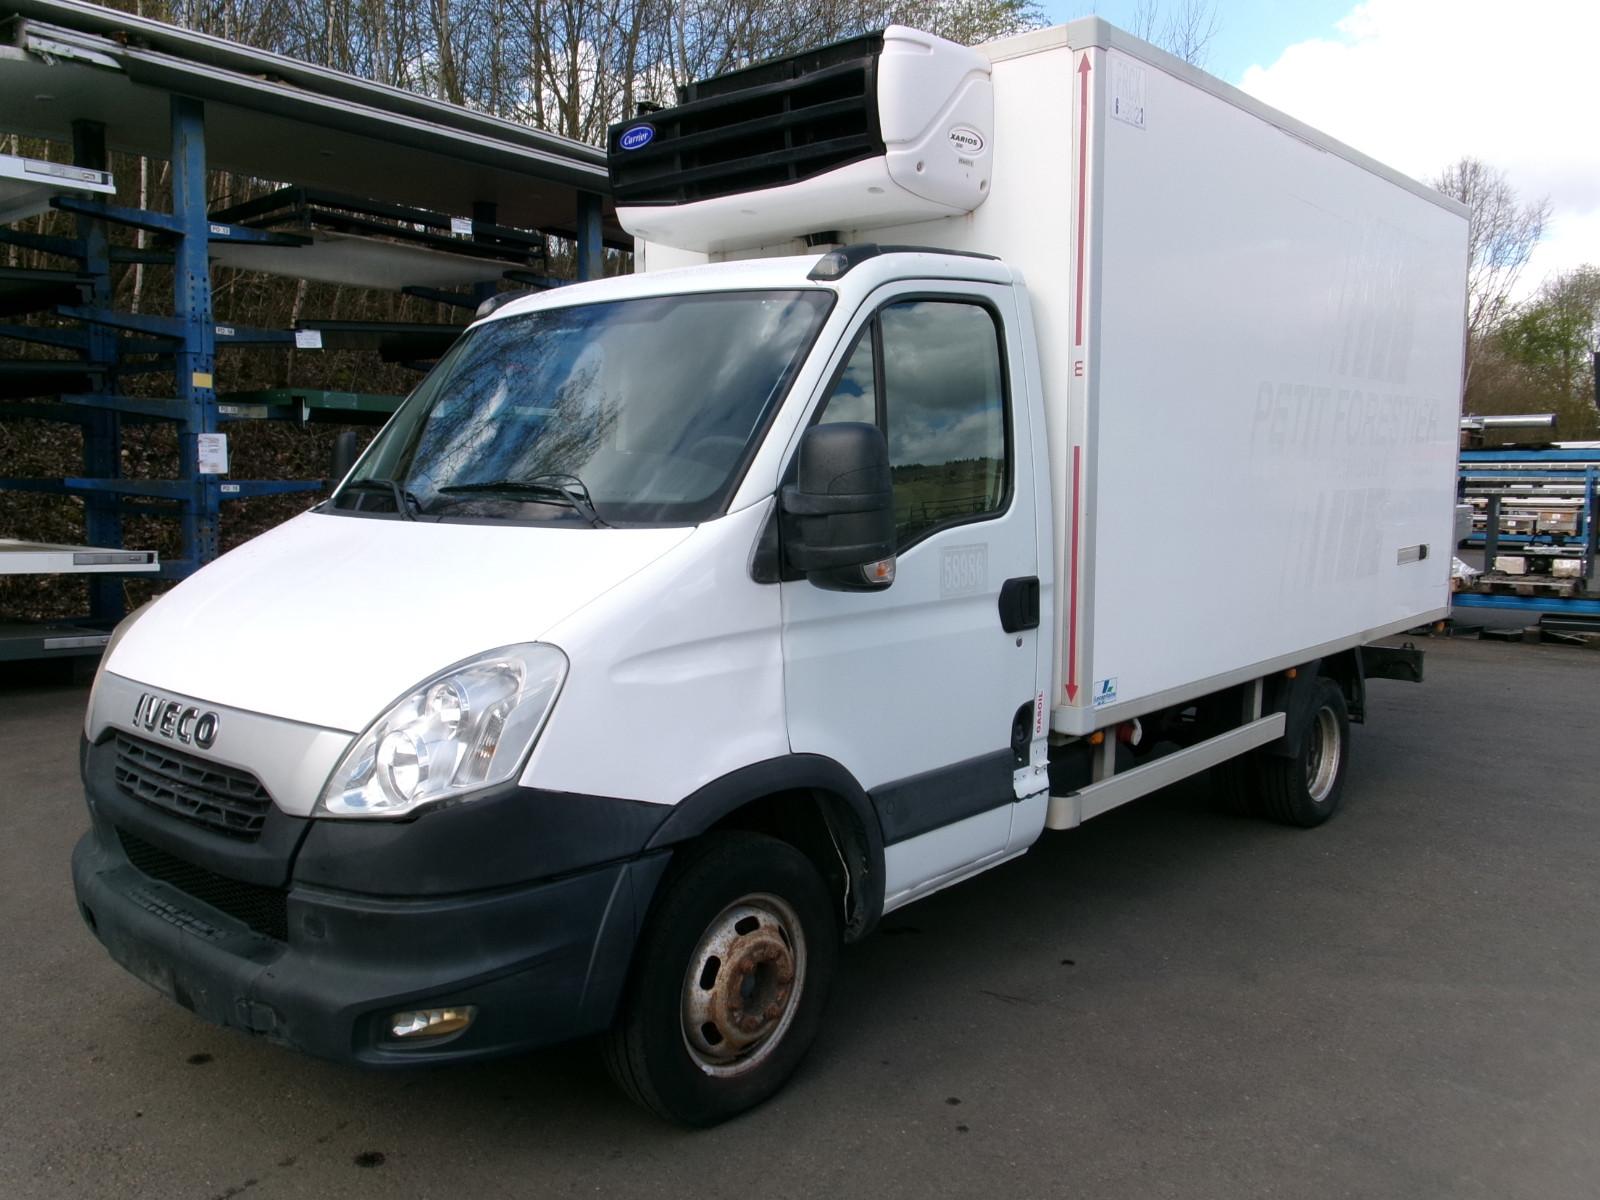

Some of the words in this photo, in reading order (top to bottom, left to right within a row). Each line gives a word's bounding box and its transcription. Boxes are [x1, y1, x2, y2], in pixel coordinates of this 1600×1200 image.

[624, 131, 649, 146] Carrier
[950, 133, 978, 146] XARIOS
[132, 692, 220, 750] IVECO
[1036, 690, 1044, 734] GASOIL
